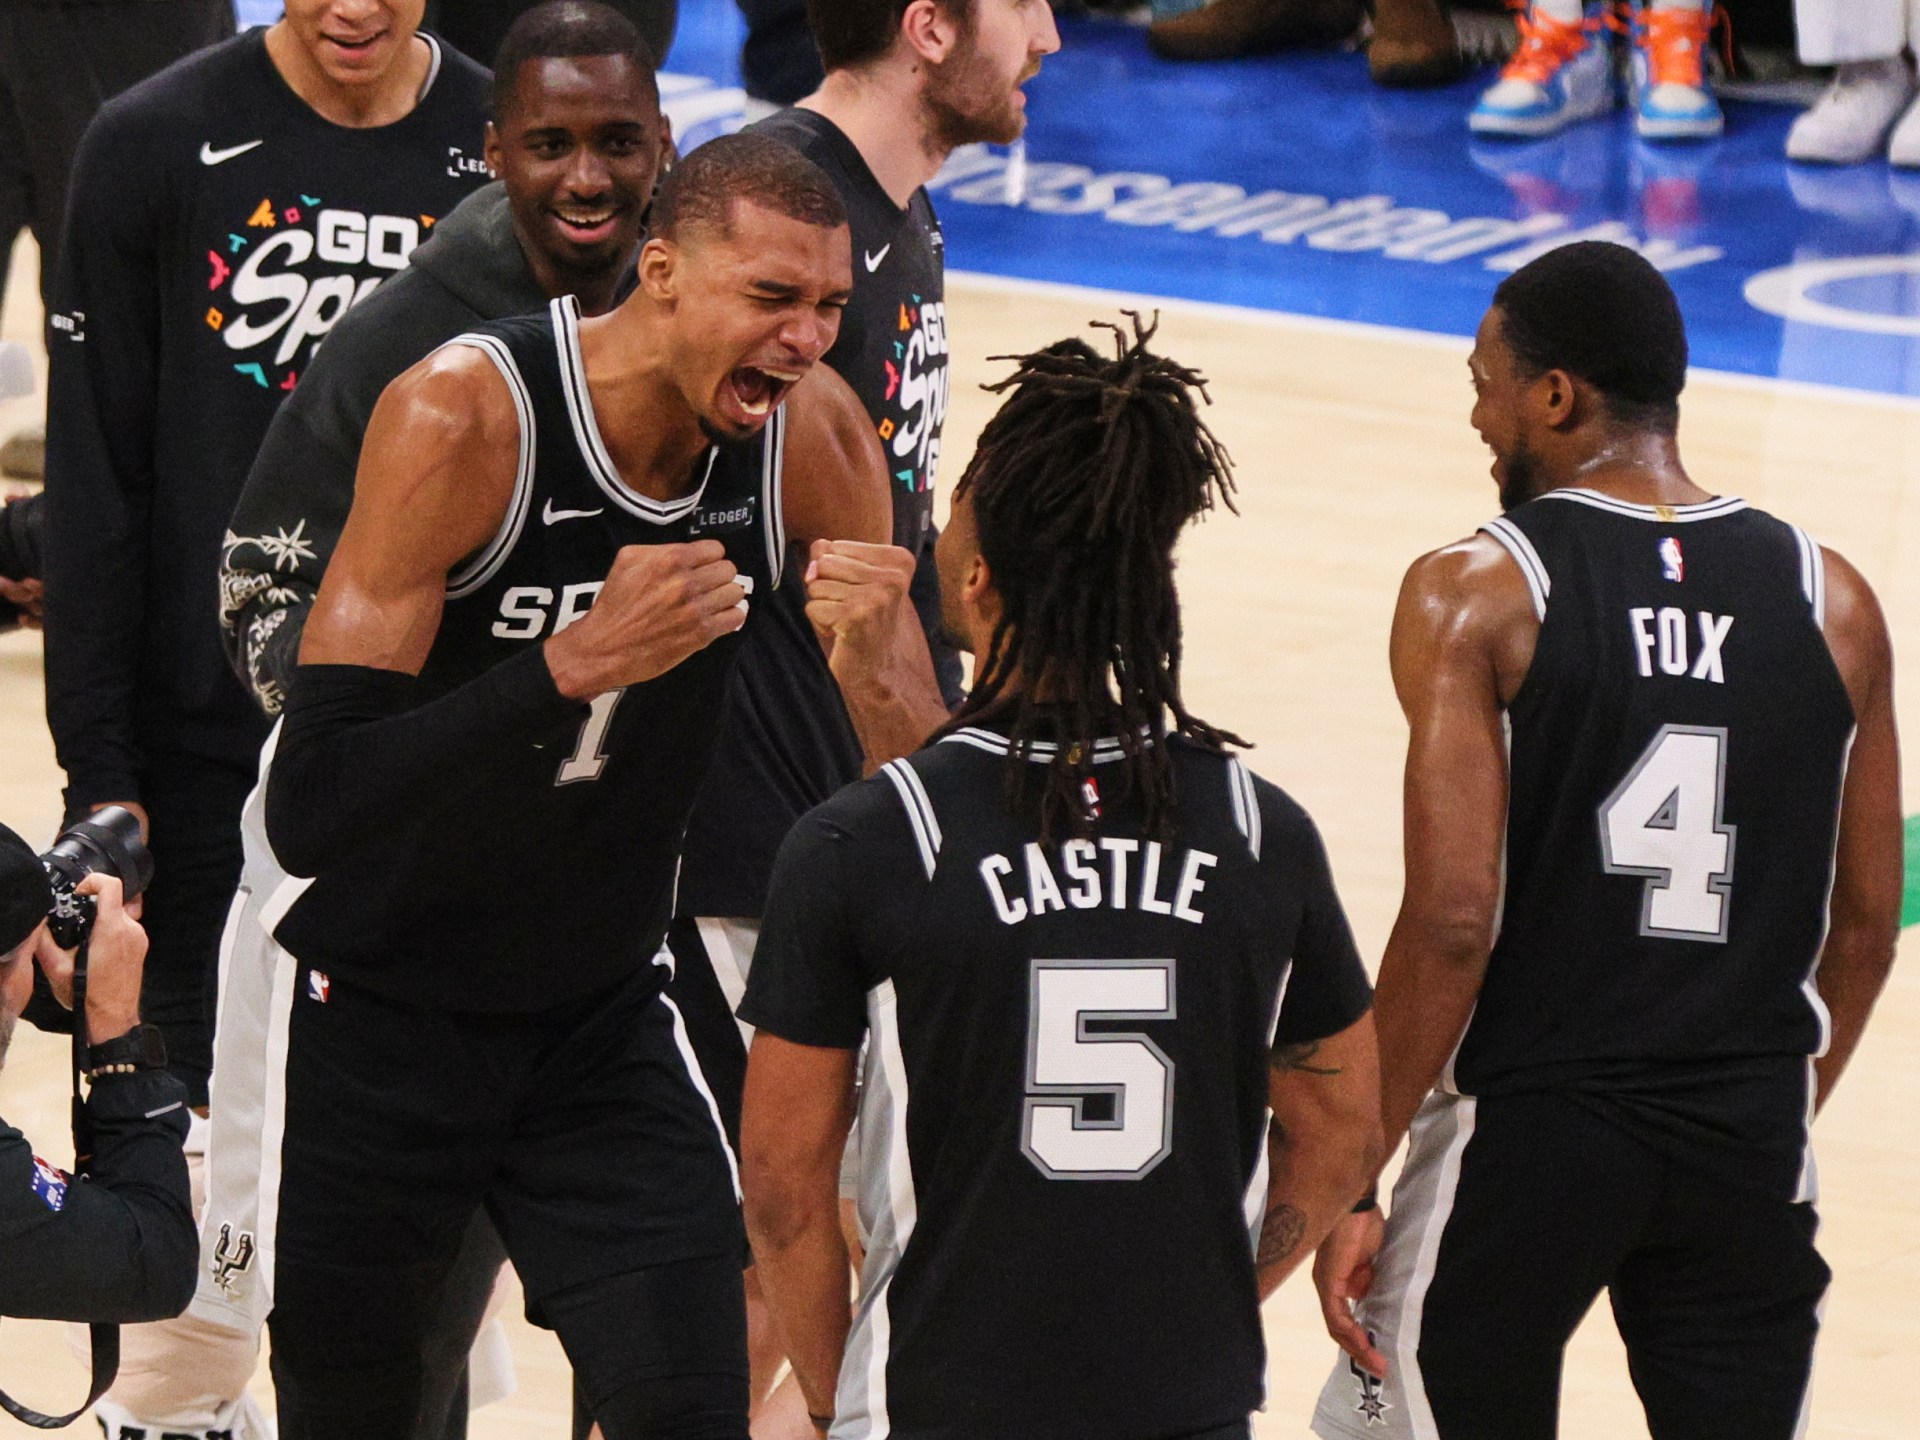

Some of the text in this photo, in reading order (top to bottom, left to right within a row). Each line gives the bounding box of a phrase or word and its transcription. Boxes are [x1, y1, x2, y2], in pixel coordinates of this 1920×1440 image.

[457, 156, 497, 179] LED
[316, 208, 419, 270] GO
[699, 506, 749, 526] LEDGER
[1629, 606, 1734, 684] FOX
[1598, 723, 1737, 944] 4
[979, 836, 1218, 925] CASTLE
[1020, 958, 1177, 1180] 5
